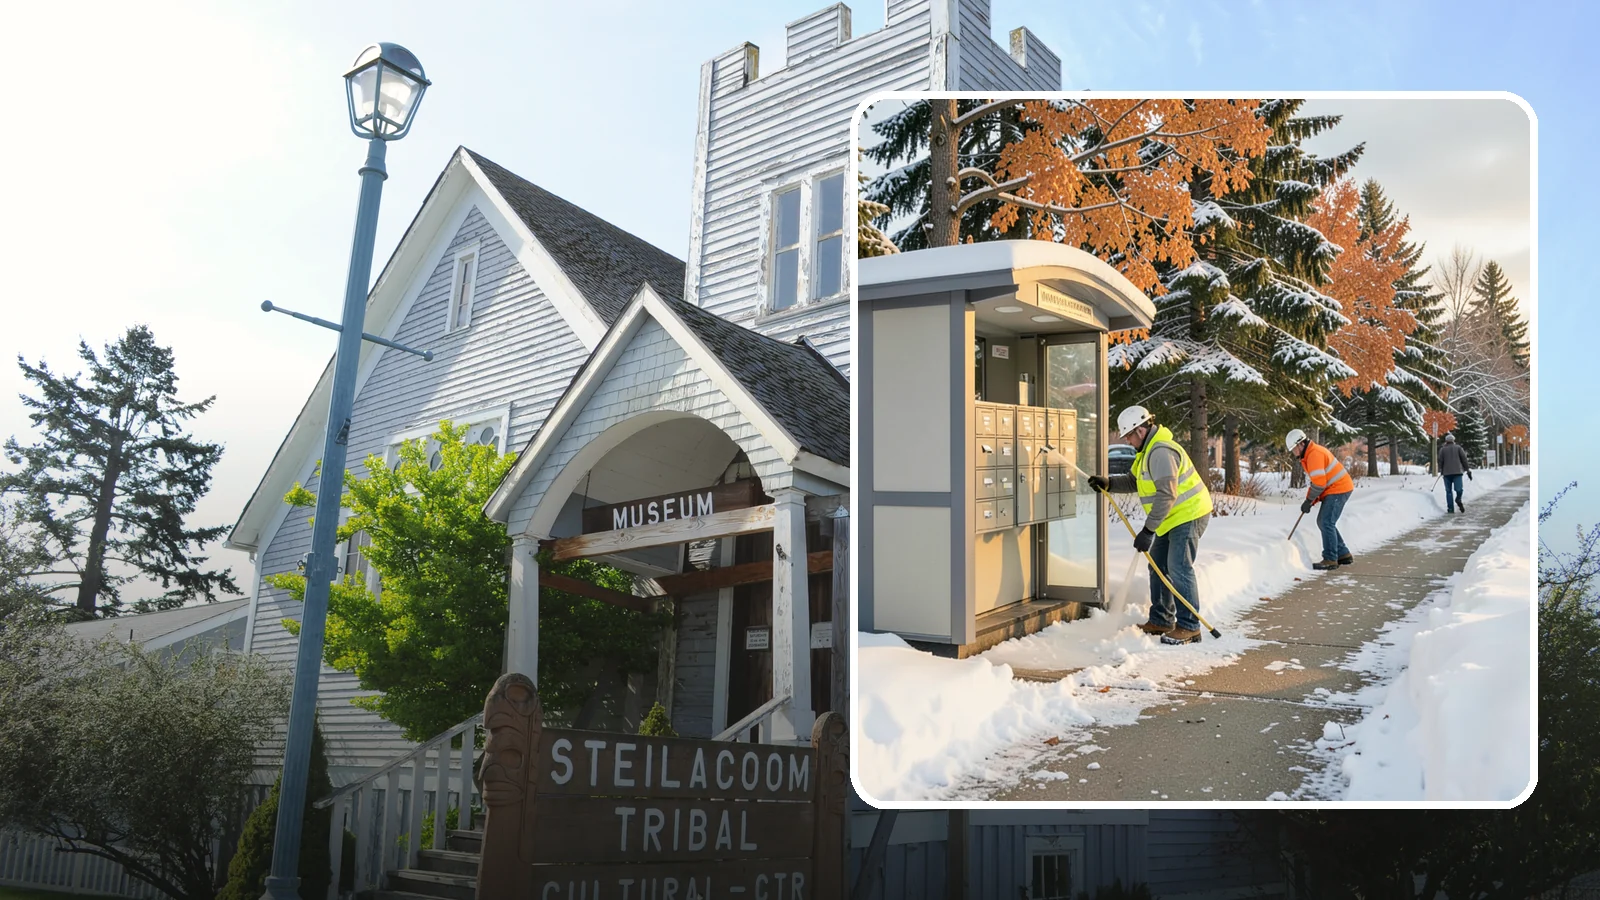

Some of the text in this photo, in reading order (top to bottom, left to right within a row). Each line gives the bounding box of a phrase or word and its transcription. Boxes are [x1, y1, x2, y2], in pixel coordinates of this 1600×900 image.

[613, 491, 714, 531] MUSEUM
[550, 738, 809, 792] STEILACOOM
[614, 807, 758, 852] TRIBAL
